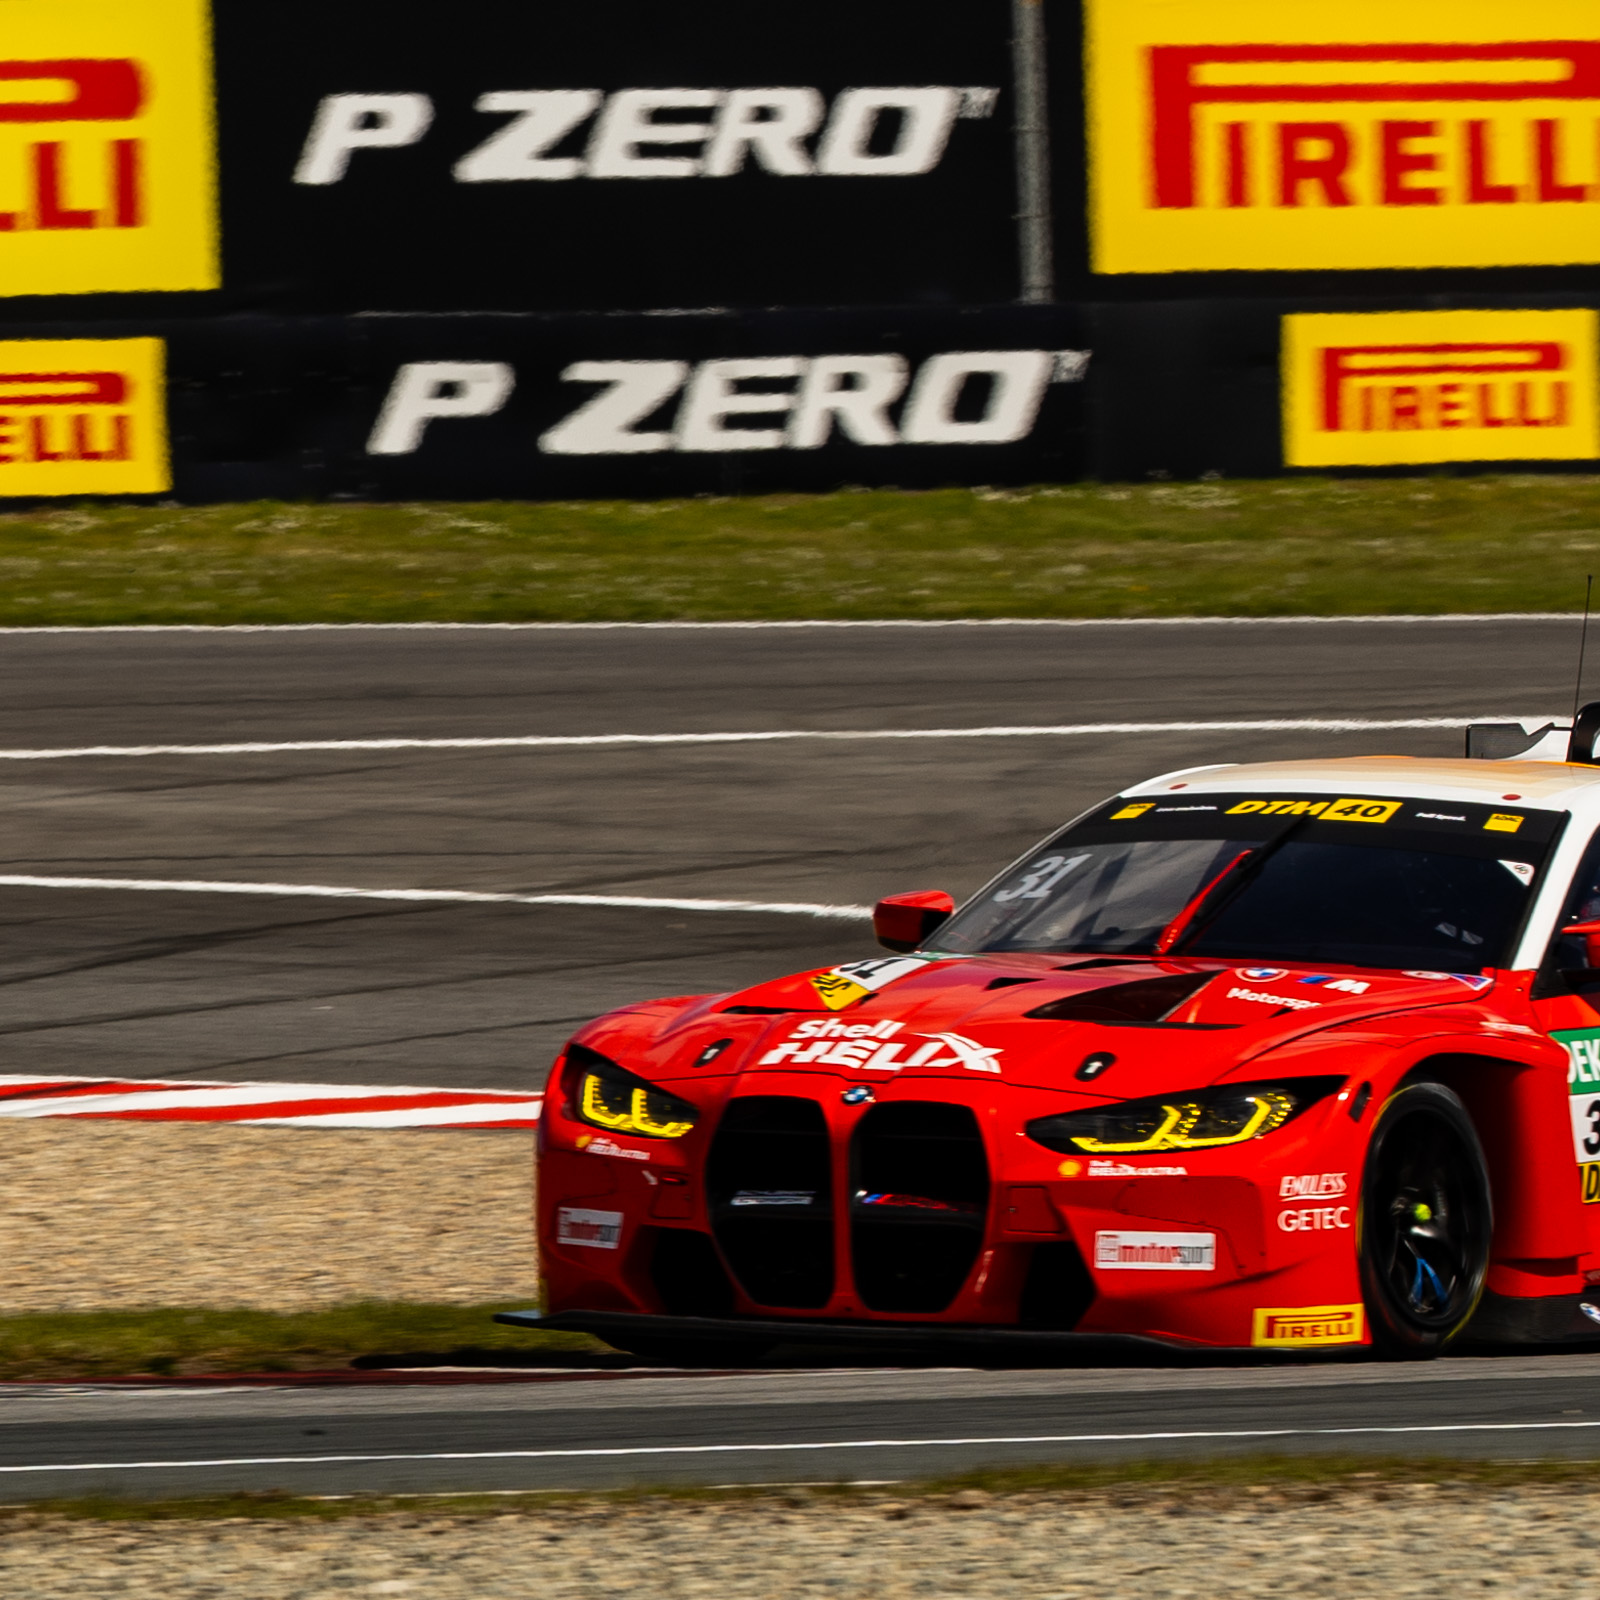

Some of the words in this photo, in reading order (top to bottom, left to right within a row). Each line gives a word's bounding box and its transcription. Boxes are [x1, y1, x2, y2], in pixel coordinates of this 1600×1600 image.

[294, 92, 435, 185] P
[1319, 341, 1570, 433] PIRELLI
[367, 360, 516, 456] P
[1225, 801, 1331, 816] DTM
[1335, 802, 1383, 819] 40
[993, 854, 1094, 902] 31
[1226, 987, 1322, 1010] Motorsp
[788, 1017, 907, 1040] Shell
[757, 1032, 1005, 1074] HELIX
[1277, 1206, 1351, 1232] GETEC
[1266, 1311, 1354, 1339] PIRELLI
